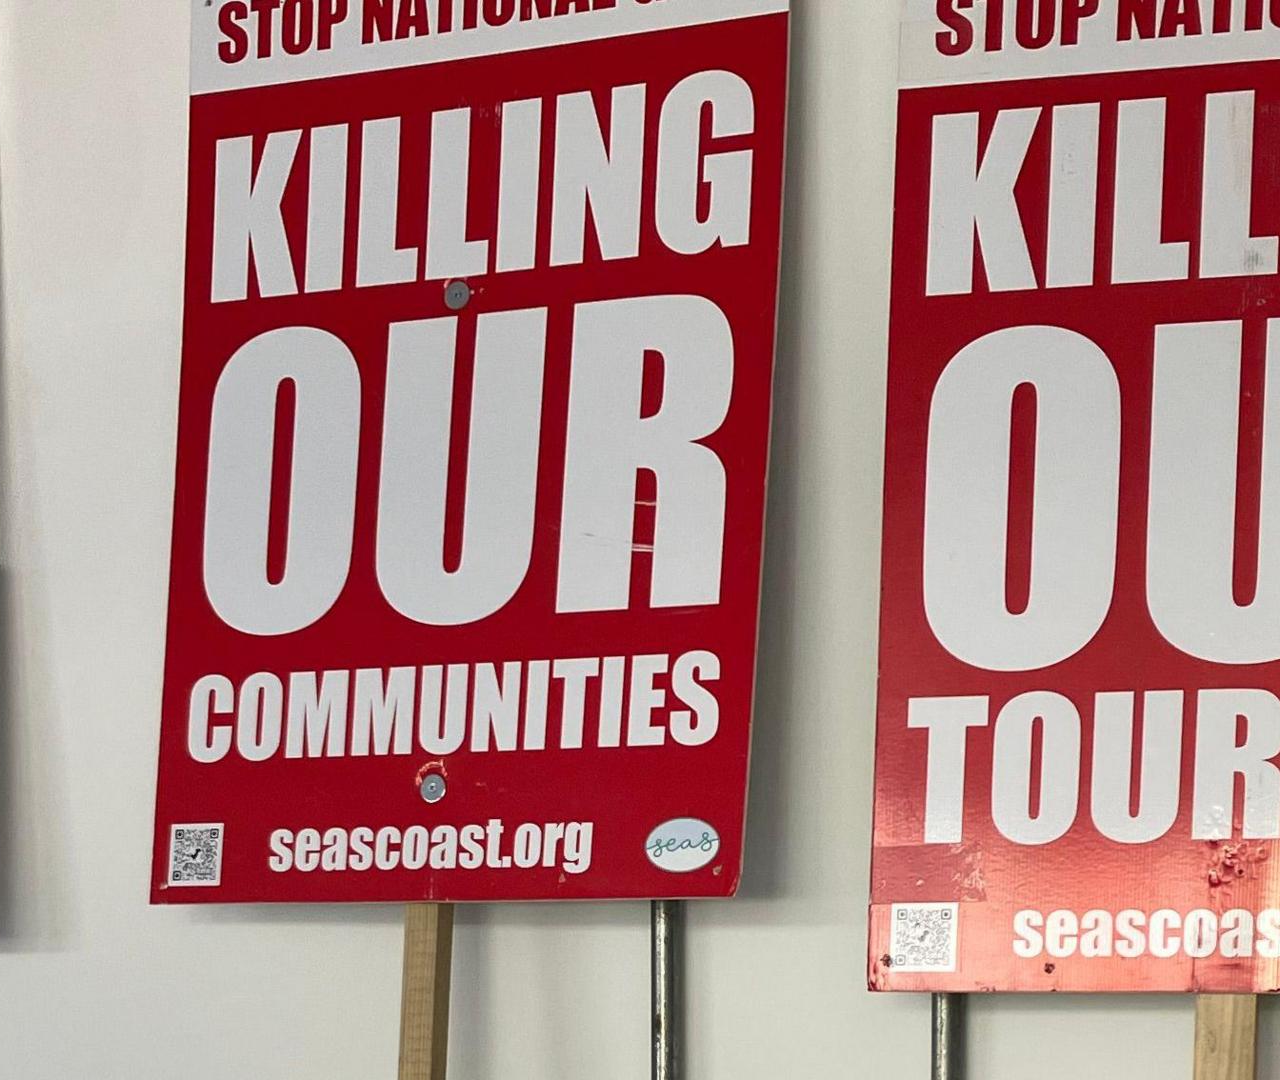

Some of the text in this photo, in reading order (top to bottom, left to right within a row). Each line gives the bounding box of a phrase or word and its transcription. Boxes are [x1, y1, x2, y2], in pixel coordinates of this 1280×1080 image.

[217, 0, 346, 64] STOP
[211, 69, 754, 303] KILLING
[203, 294, 734, 636] OUR
[187, 650, 720, 763] COMMUNITIES
[268, 818, 593, 873] seascoast.org
[646, 831, 717, 857] seas
